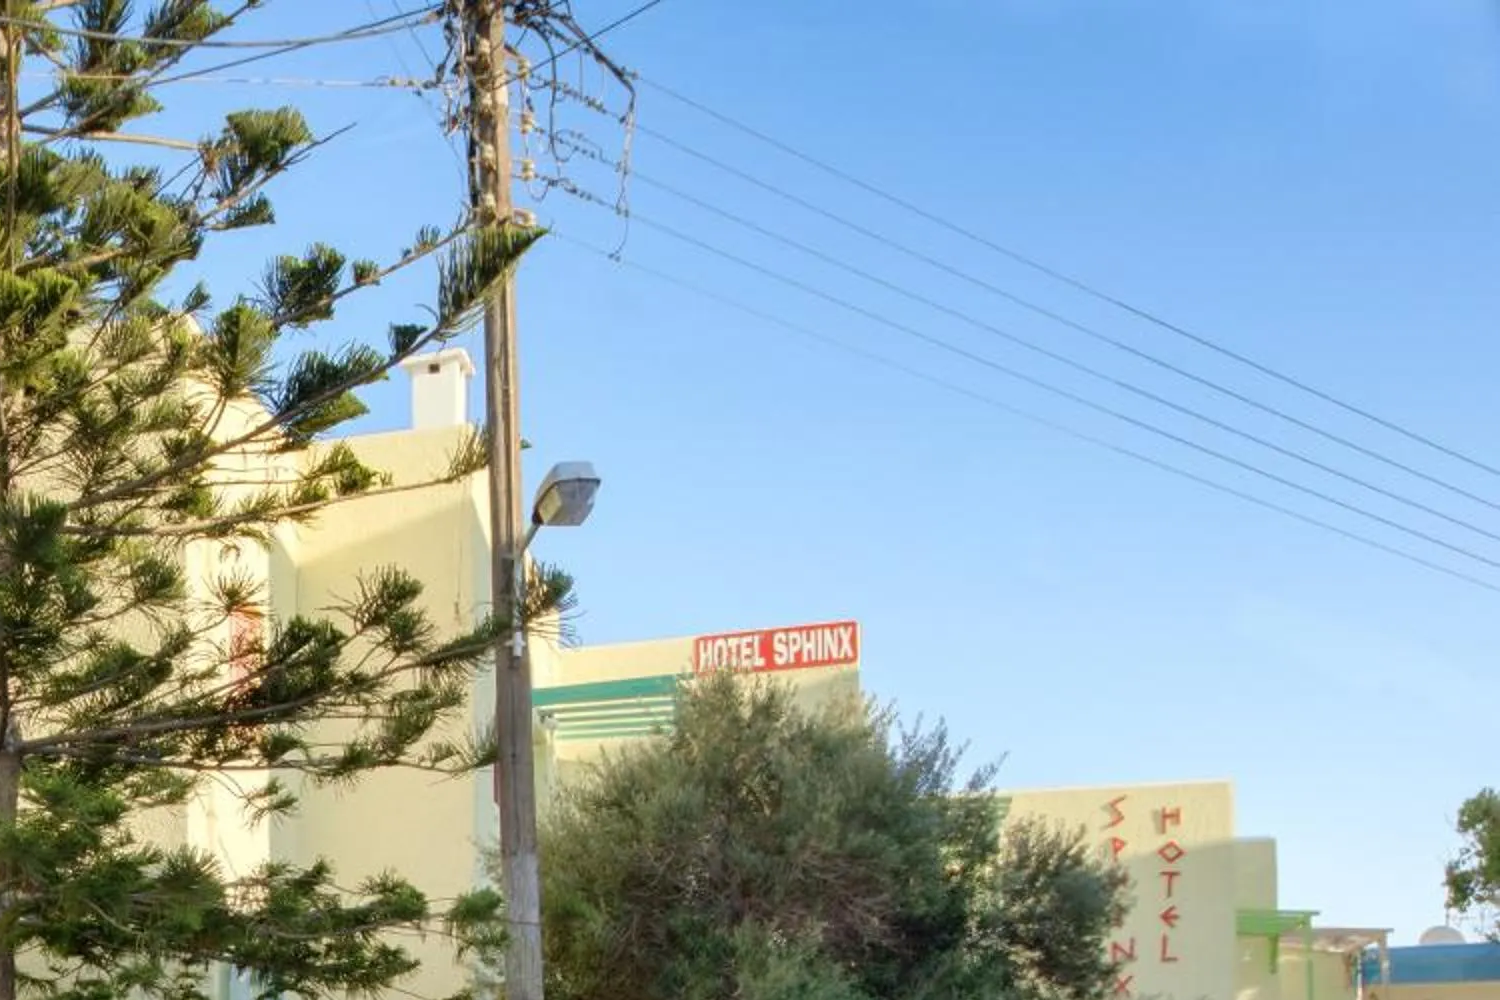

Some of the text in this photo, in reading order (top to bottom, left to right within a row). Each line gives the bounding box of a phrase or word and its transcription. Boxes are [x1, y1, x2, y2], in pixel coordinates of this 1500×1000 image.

[699, 626, 853, 672] HOTEL SPHINX
[1102, 794, 1137, 998] SPNX
[1157, 806, 1185, 963] HOTEL
